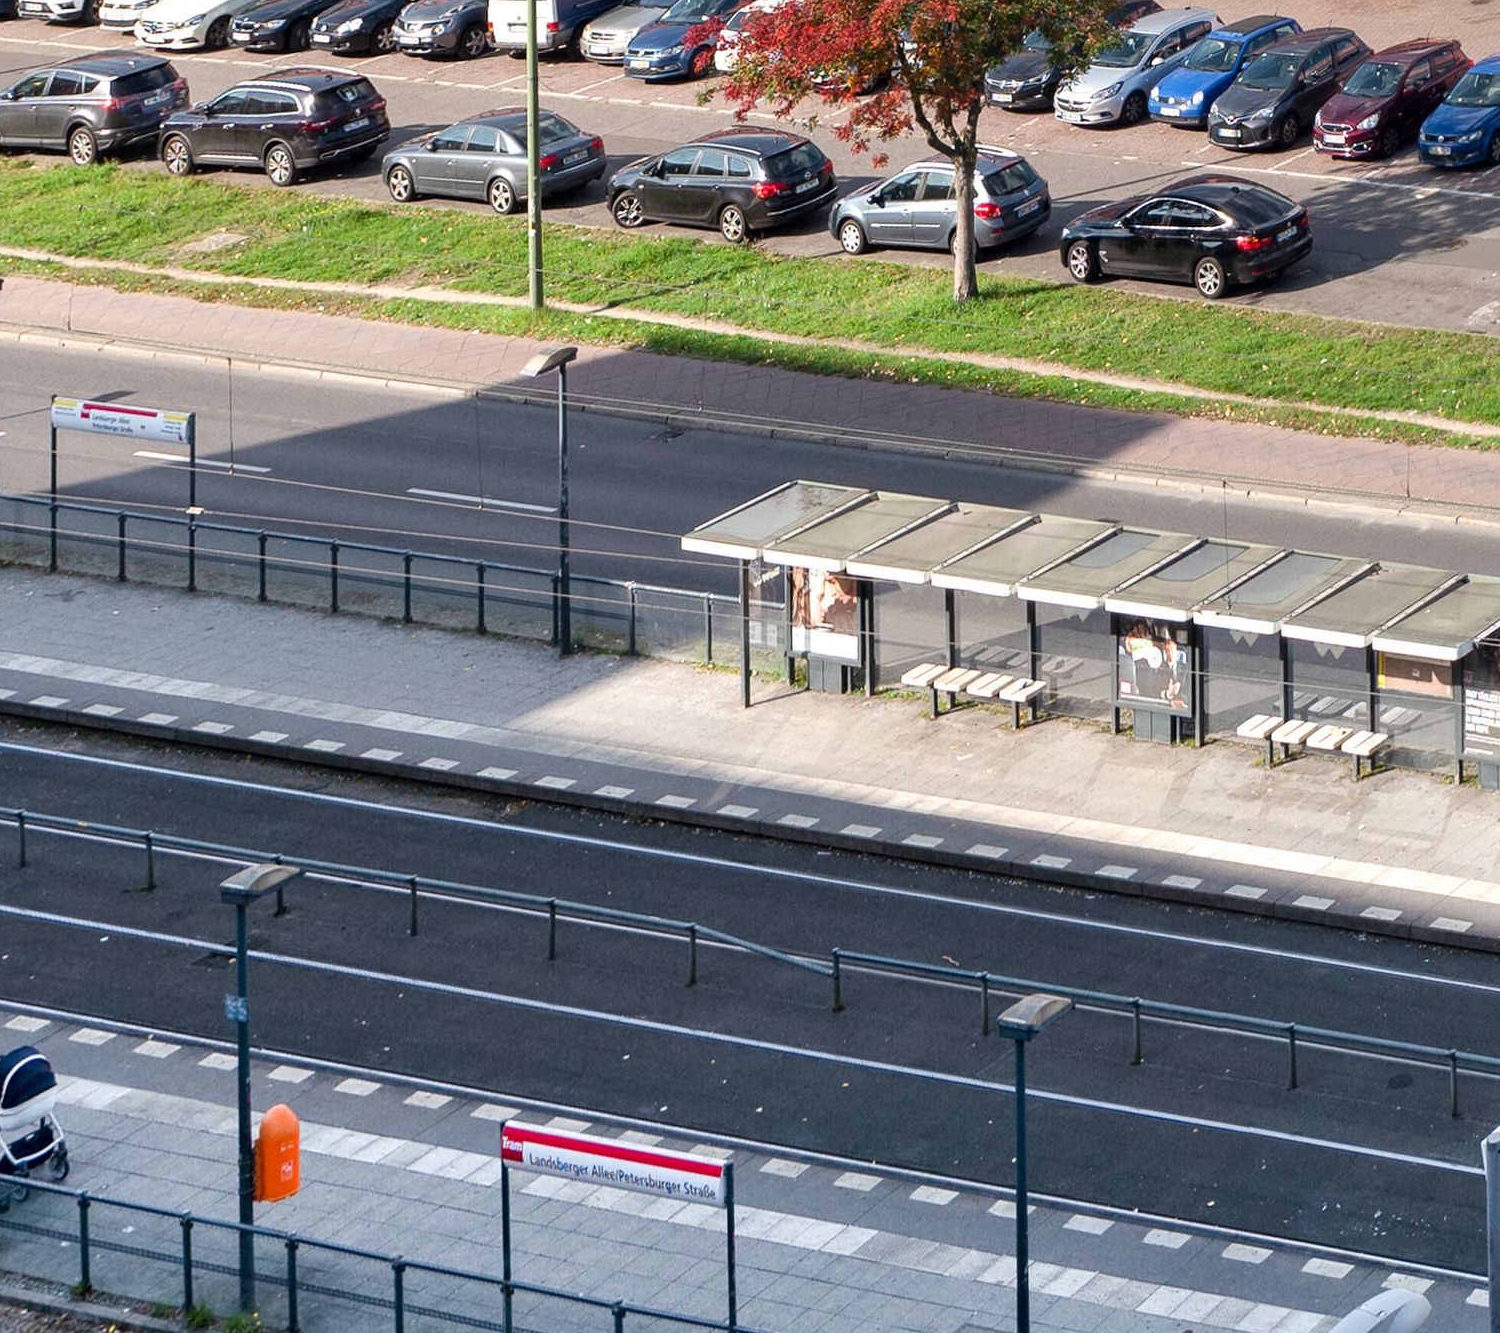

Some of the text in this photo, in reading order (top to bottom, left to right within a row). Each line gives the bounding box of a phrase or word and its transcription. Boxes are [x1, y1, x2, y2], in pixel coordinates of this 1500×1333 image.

[502, 1135, 523, 1152] Tram
[528, 1153, 717, 1201] Landsberger Allee/Petersburger Straße
